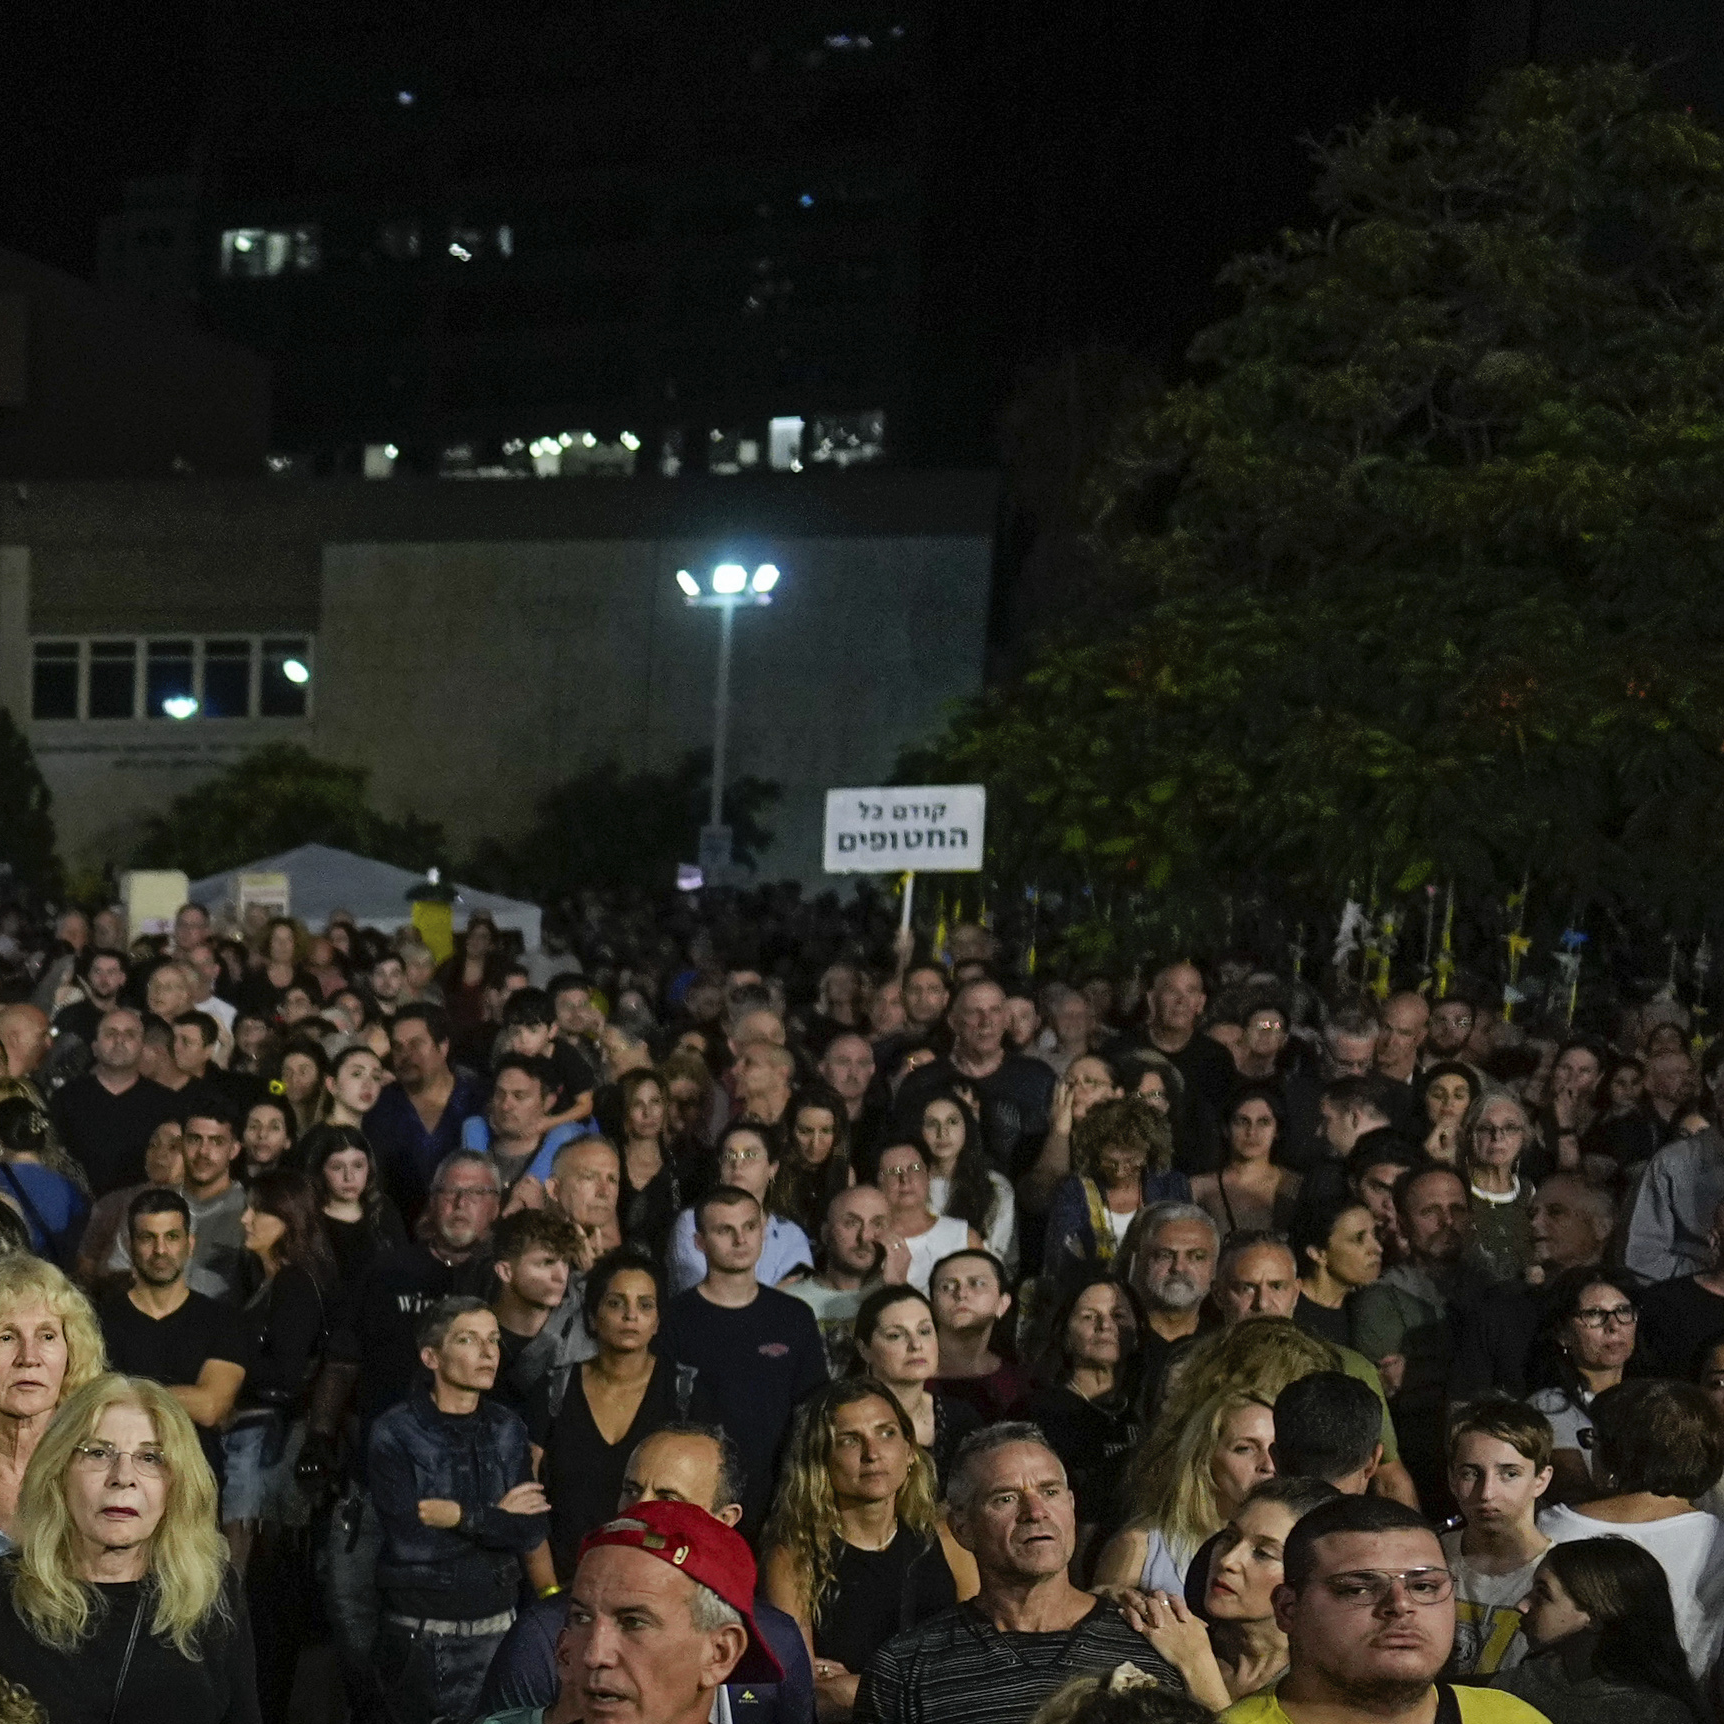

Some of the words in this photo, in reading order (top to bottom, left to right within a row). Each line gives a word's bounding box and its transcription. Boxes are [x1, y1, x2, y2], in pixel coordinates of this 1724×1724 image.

[857, 799, 884, 821] כל
[892, 802, 947, 824] קודם
[837, 826, 969, 853] החטופים
